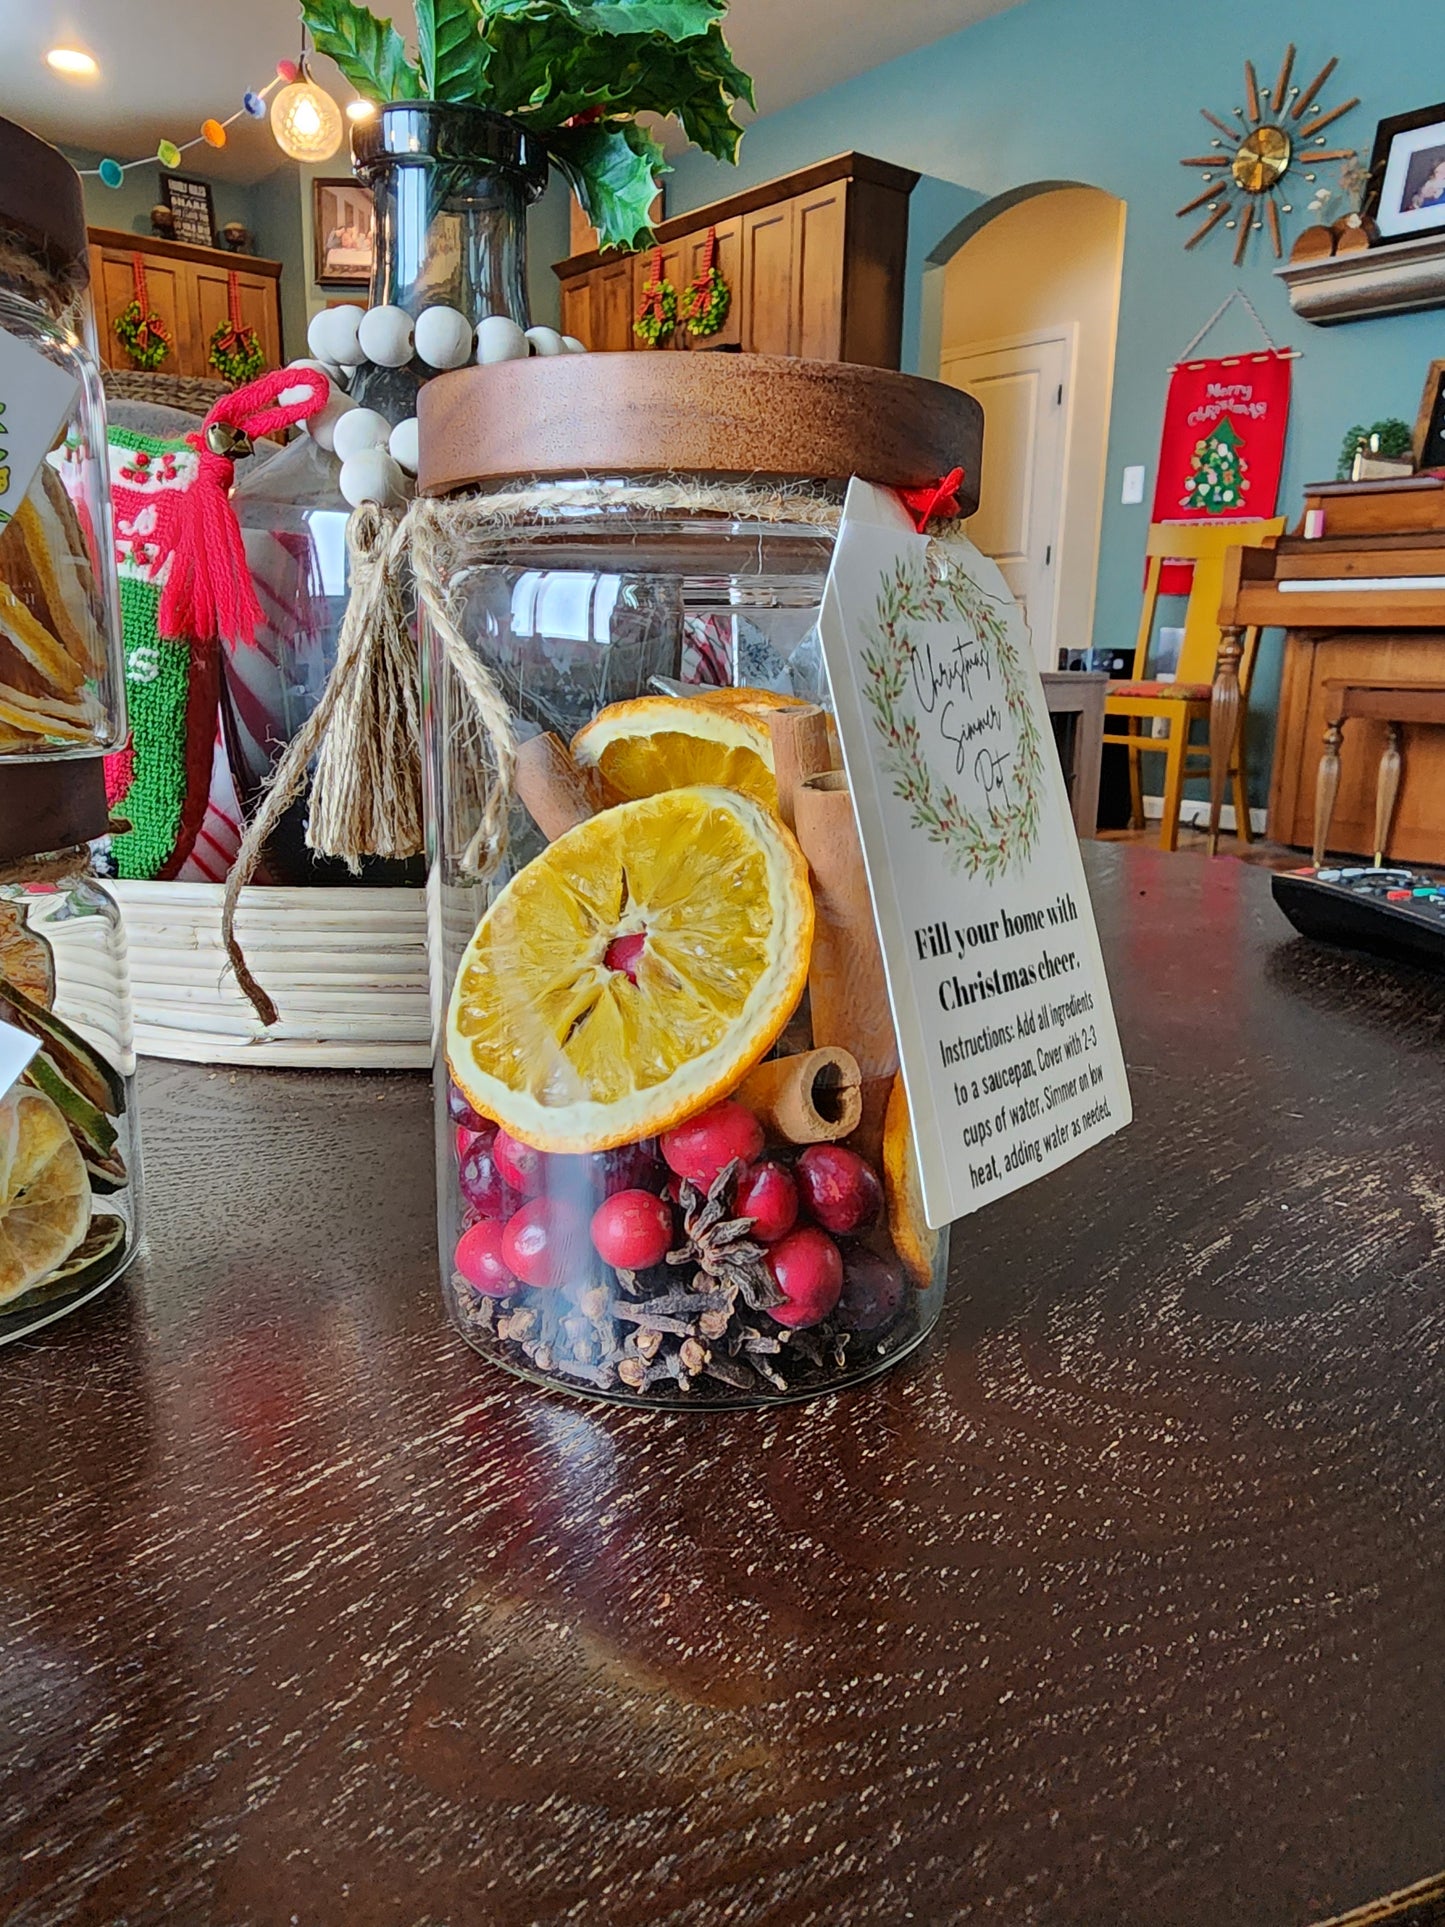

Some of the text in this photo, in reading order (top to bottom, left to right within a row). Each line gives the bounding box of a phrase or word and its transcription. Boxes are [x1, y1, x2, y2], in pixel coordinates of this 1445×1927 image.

[1206, 383, 1253, 402] Merry
[910, 636, 991, 713] Christmas
[940, 699, 1001, 774] Simmer
[974, 748, 1010, 822] Pot
[914, 892, 1078, 960] Fill your home with
[938, 949, 1081, 1012] Christmas cheer.
[939, 991, 1094, 1068] Instructions: Add all ingredients
[954, 1024, 1098, 1106] to a saucepan. Cover with 2-3
[963, 1062, 1104, 1148] cups of water. Simmer on low
[969, 1095, 1112, 1190] heat, adding water as needed.
